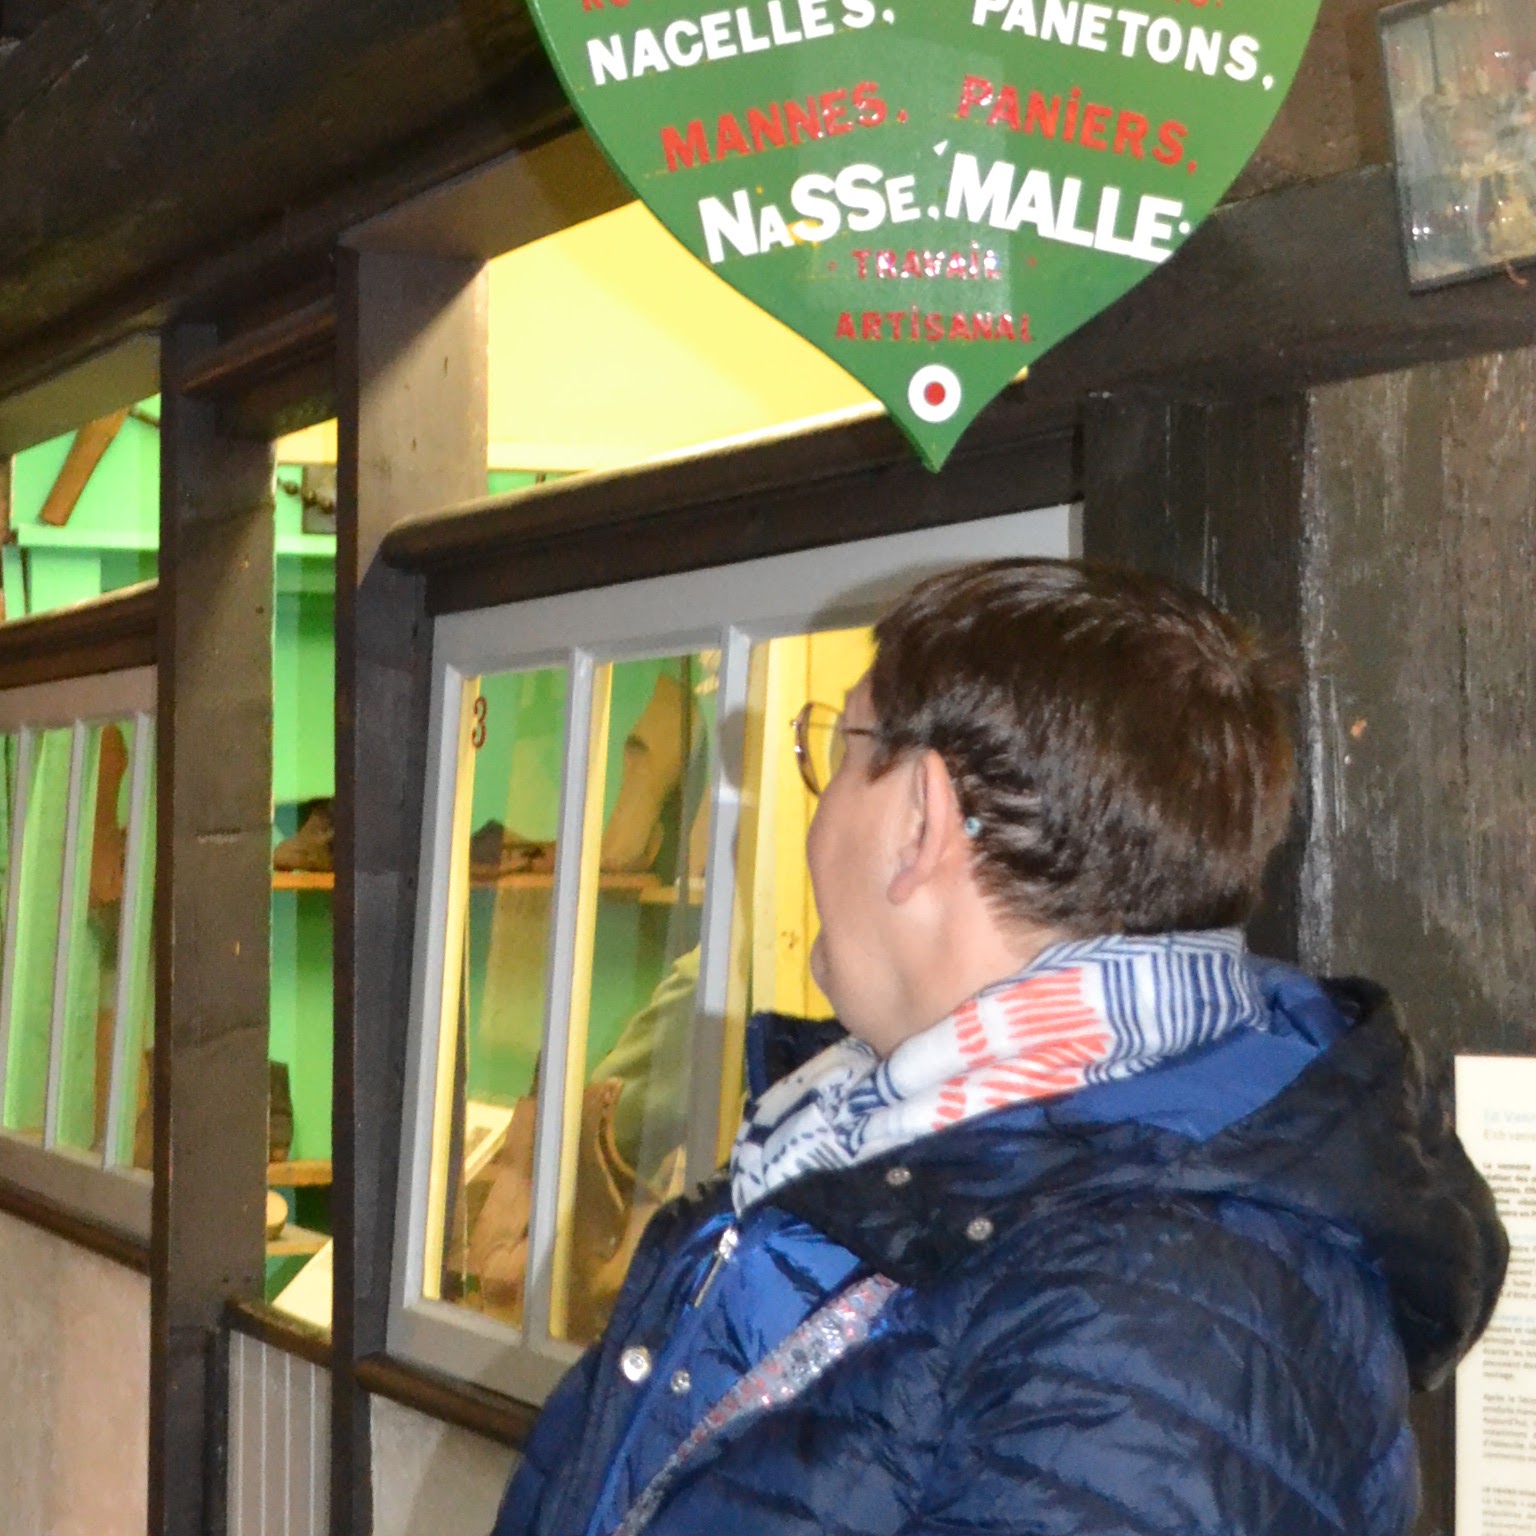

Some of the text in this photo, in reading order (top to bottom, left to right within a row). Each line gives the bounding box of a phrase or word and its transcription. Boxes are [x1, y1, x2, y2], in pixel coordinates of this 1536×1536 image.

[851, 240, 1002, 280] TRAVAIL
[835, 304, 1033, 343] ARTISANAL
[472, 696, 487, 748] 3
